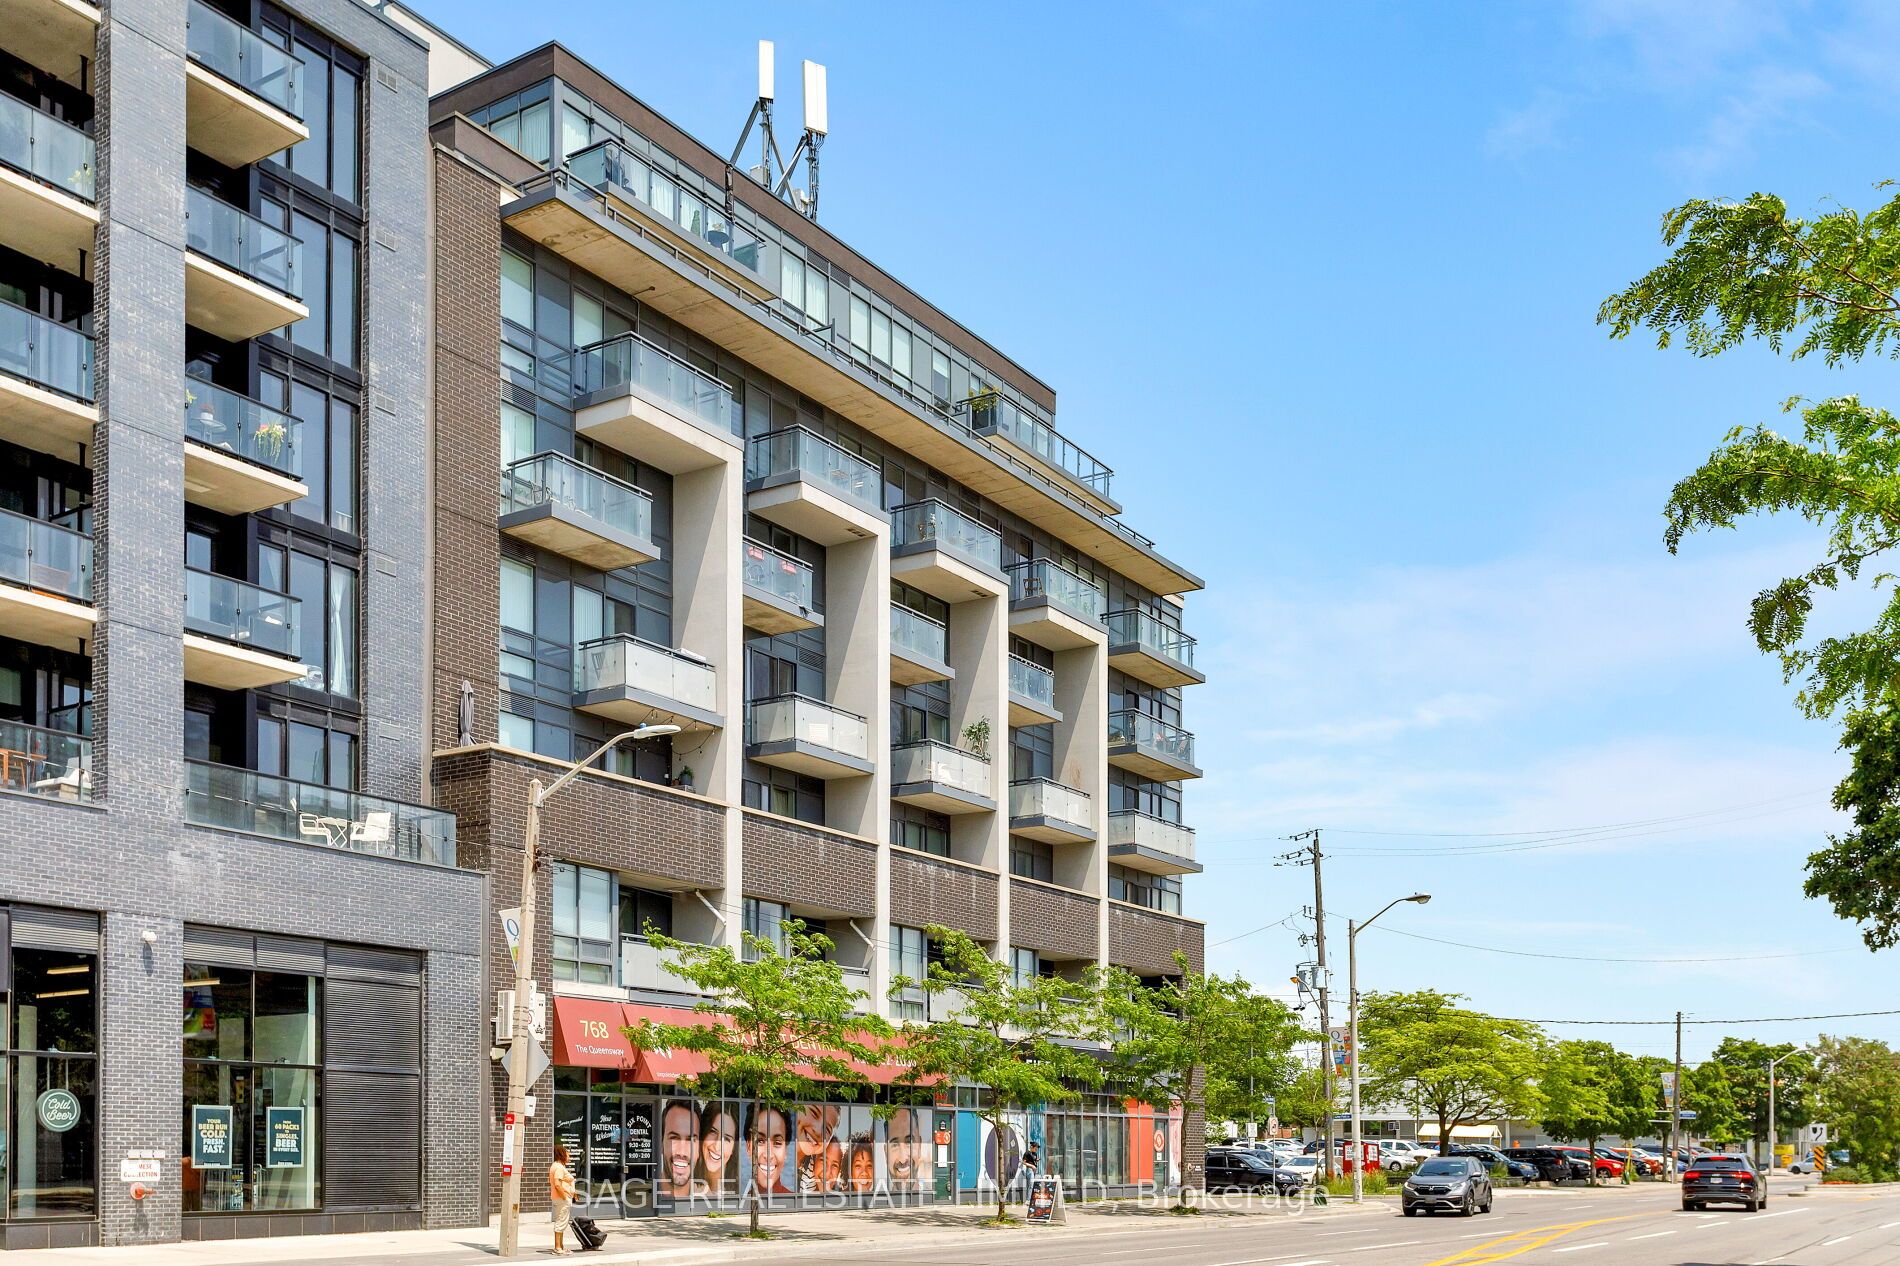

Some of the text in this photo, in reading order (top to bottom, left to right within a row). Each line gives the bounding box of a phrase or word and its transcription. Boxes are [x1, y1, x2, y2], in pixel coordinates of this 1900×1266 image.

[580, 1020, 609, 1039] 768
[576, 1044, 624, 1056] The Queensway
[48, 1098, 71, 1110] Cold
[47, 1109, 73, 1121] Beer
[591, 1123, 620, 1131] PATIENTS
[627, 1115, 652, 1129] SIX POINT
[200, 1130, 228, 1139] COLD.
[203, 1145, 225, 1153] FAST.
[276, 1139, 296, 1147] BEER
